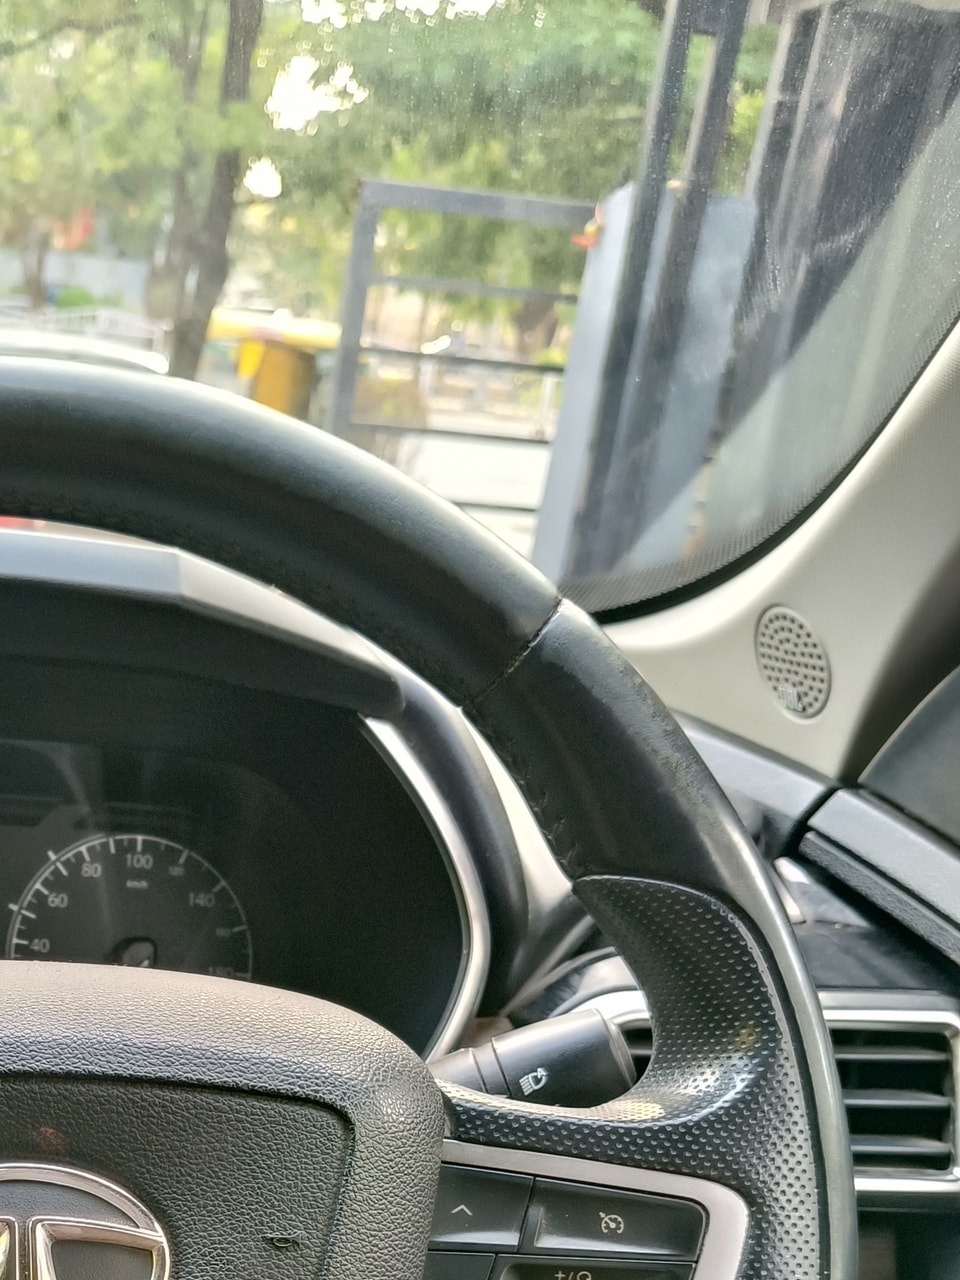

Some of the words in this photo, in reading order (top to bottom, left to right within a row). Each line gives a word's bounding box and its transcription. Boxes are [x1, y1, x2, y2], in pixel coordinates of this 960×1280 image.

[126, 854, 153, 869] 100
[81, 864, 102, 878] 80
[48, 894, 68, 908] 60
[189, 893, 215, 907] 140
[29, 938, 50, 953] 40
